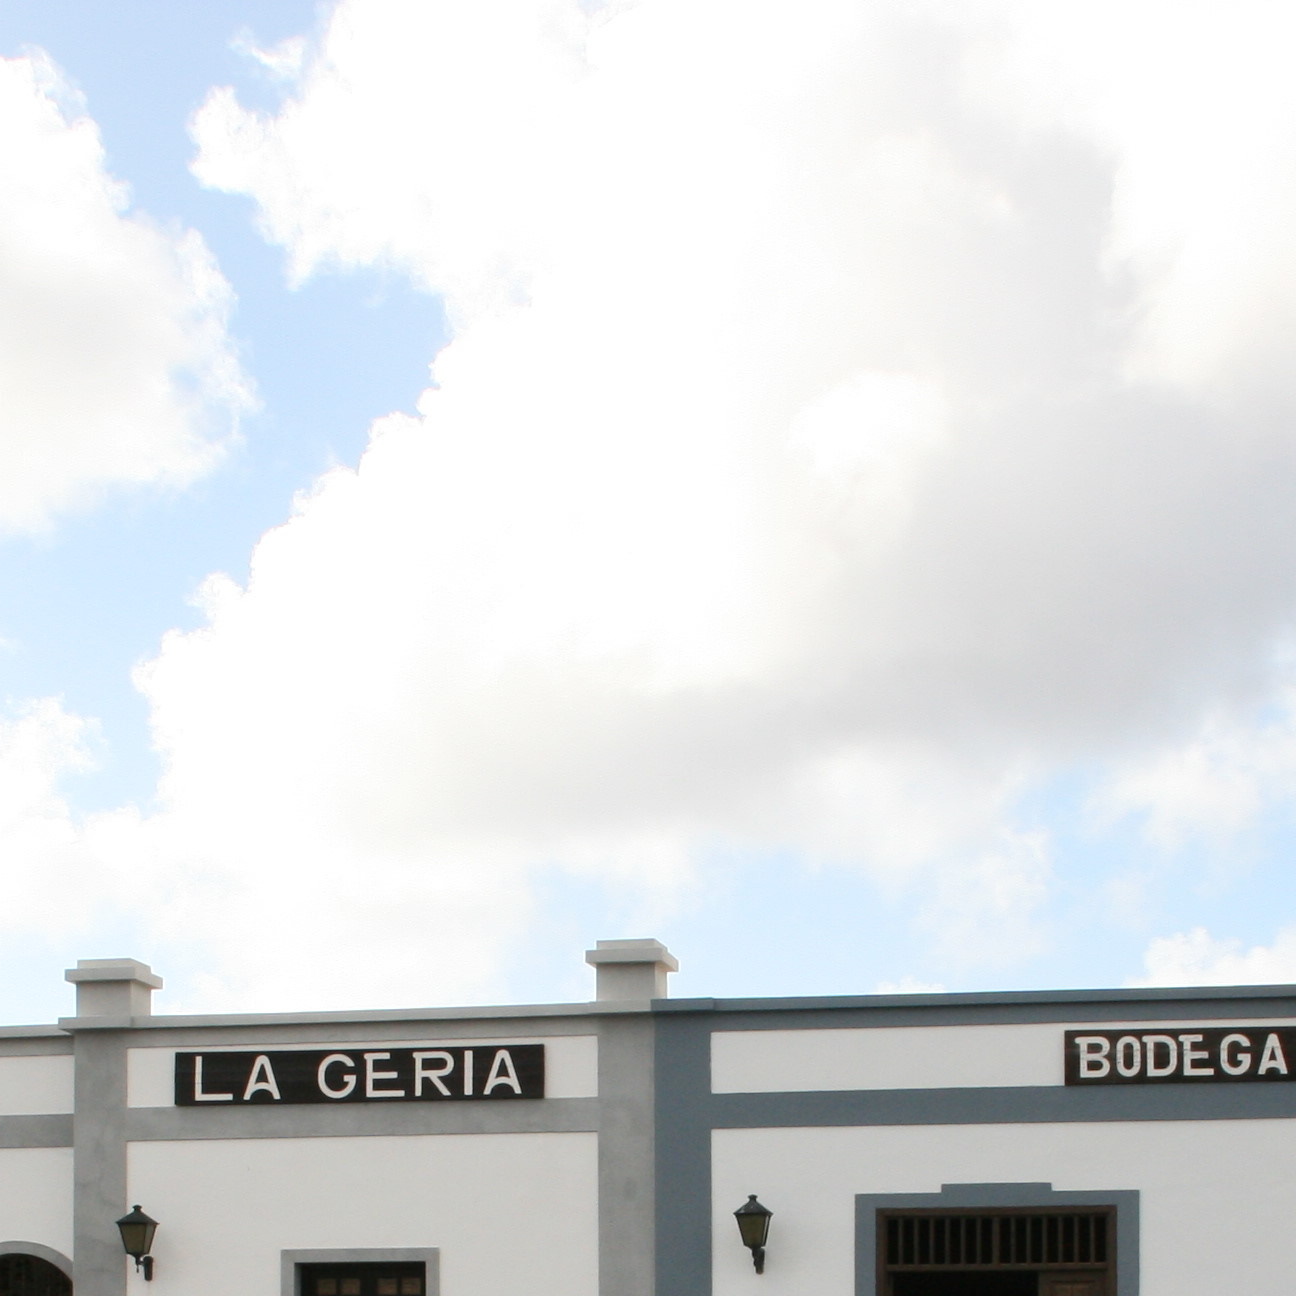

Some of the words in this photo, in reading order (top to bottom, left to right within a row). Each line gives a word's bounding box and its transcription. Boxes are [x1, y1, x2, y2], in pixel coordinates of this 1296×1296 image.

[193, 1053, 282, 1102] LA
[316, 1049, 523, 1099] GERIA
[1073, 1033, 1289, 1079] BODEGA
